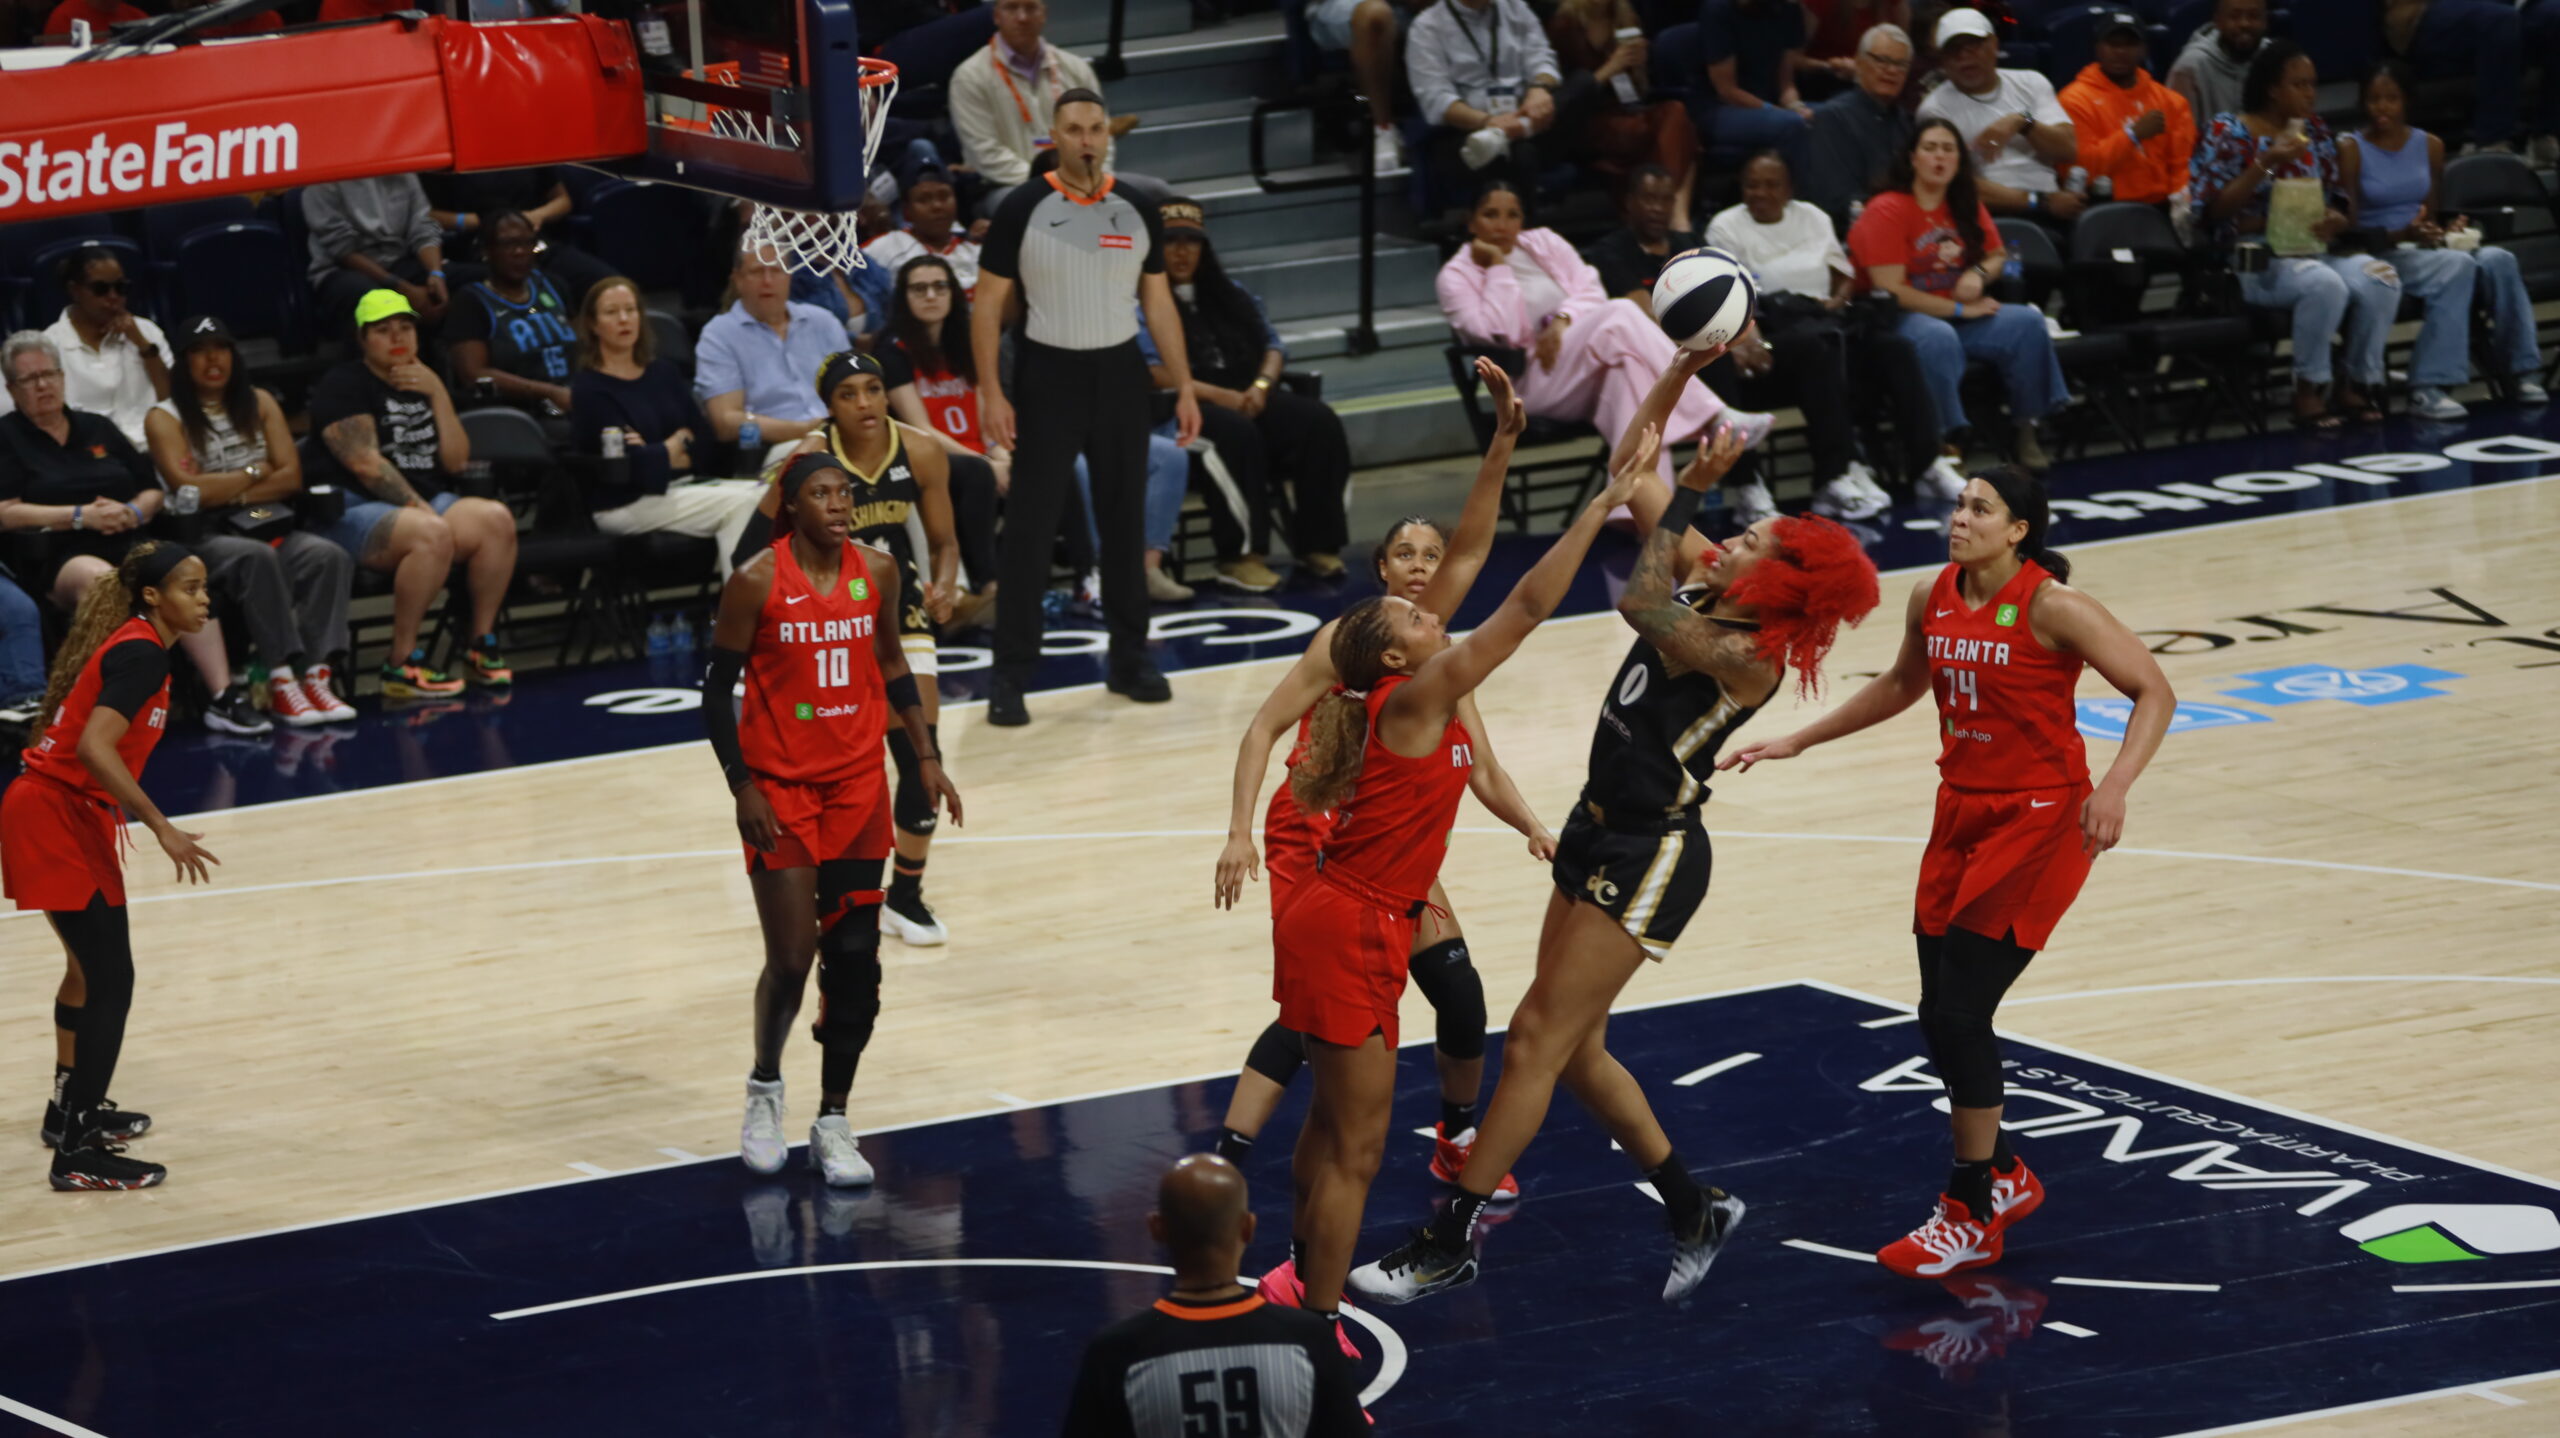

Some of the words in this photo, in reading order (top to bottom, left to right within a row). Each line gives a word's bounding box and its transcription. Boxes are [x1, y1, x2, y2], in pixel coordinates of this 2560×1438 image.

[944, 405, 969, 435] 0
[1902, 434, 2560, 530] Deloitt.
[780, 615, 873, 643] ATLANTA
[1927, 635, 2010, 665] ATLANTA
[814, 647, 850, 688] 10
[1618, 662, 1649, 706] 0
[1942, 666, 1979, 712] 74
[1971, 728, 1992, 743] App
[1857, 1055, 2373, 1217] VANDA
[2016, 1066, 2426, 1183] PHARMACEUTICALS
[1178, 1366, 1262, 1438] 59
